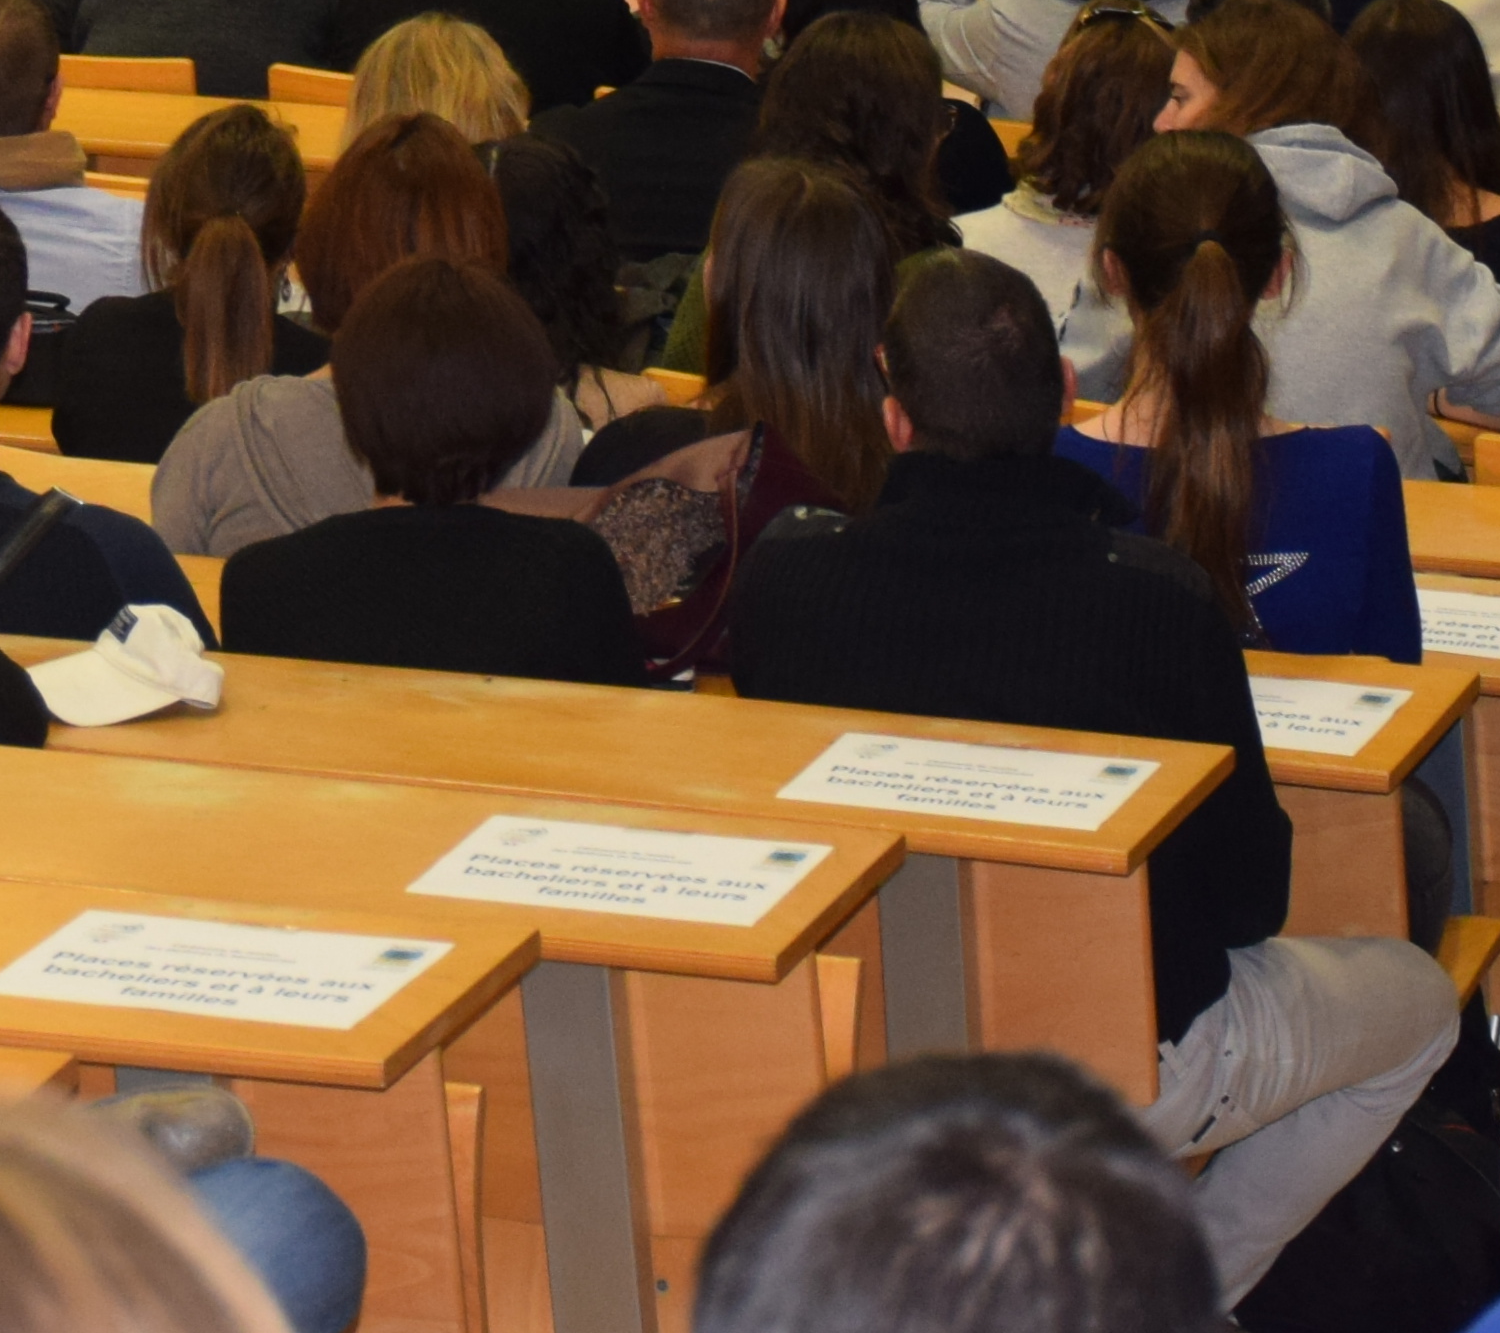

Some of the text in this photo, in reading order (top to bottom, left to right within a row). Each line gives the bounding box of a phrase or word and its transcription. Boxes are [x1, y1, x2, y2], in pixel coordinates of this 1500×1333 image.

[1422, 637, 1500, 651] amilles
[1475, 632, 1498, 642] et
[1286, 721, 1347, 736] leurs
[1318, 715, 1363, 727] aux
[831, 764, 916, 779] Places
[924, 773, 1051, 792] réservées
[1058, 789, 1107, 799] aux
[826, 776, 1090, 808] bacheliers et à leurs
[896, 793, 997, 809] familles
[469, 852, 562, 869] Places
[570, 861, 708, 883] réservées
[716, 879, 770, 891] aux
[463, 865, 748, 902] bacheliers et à leurs
[536, 884, 647, 903] familles
[53, 949, 154, 968] Places
[161, 958, 310, 984] réservées
[319, 978, 376, 991] aux
[42, 963, 351, 1004] bacheliers et à leurs
[119, 985, 239, 1005] familles
